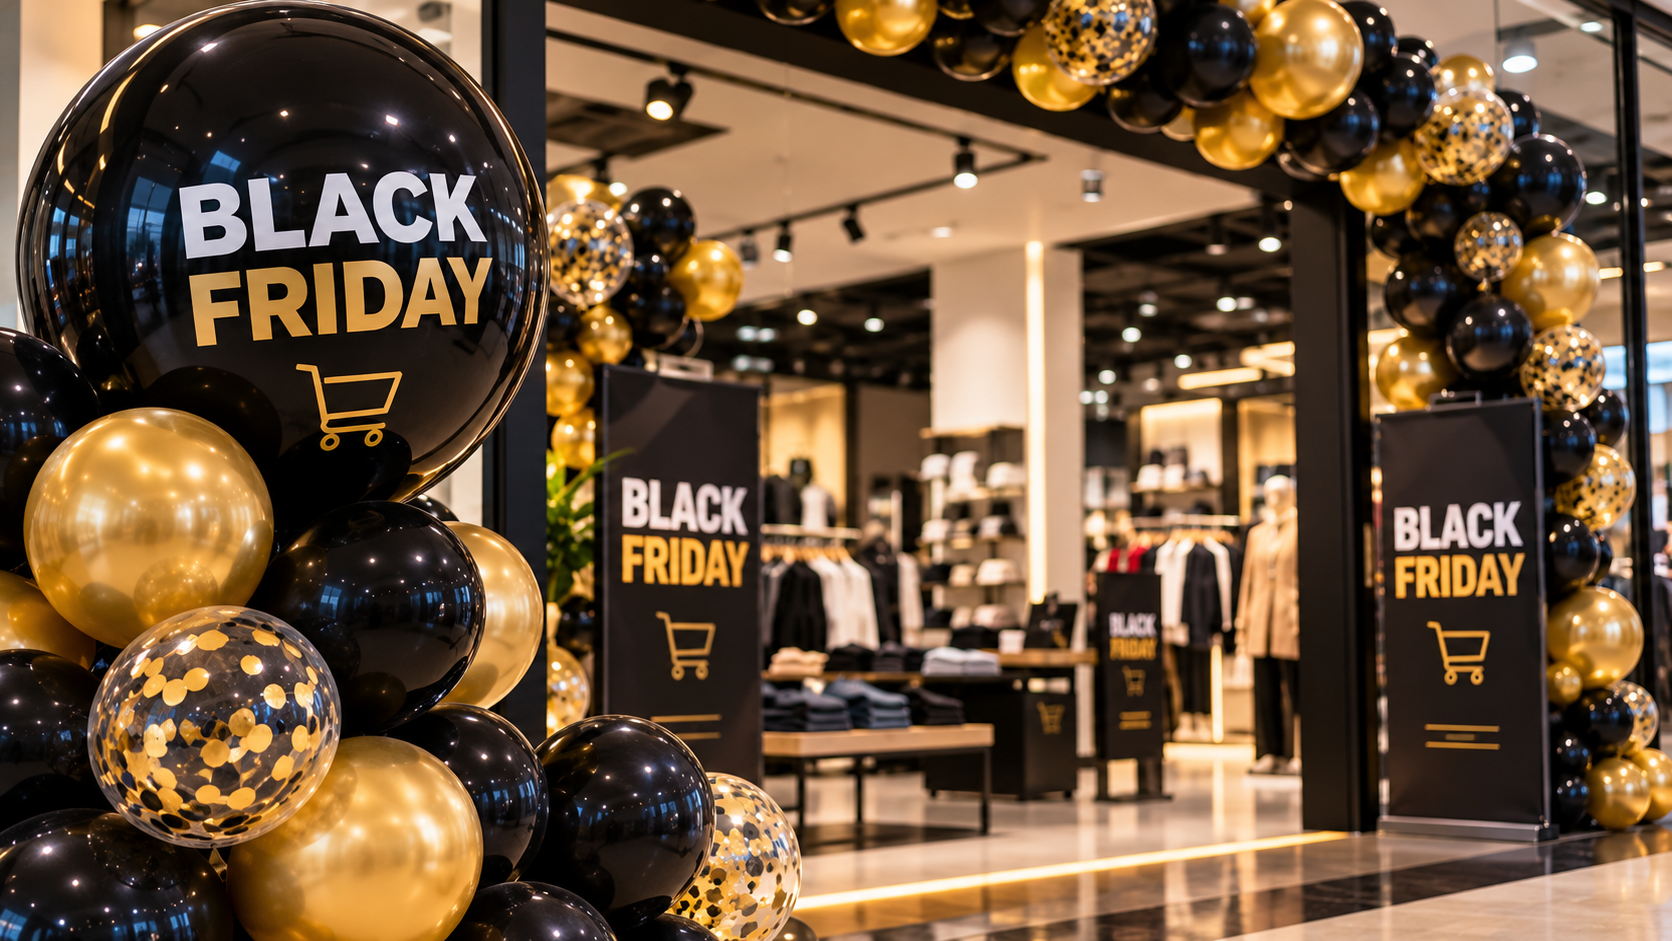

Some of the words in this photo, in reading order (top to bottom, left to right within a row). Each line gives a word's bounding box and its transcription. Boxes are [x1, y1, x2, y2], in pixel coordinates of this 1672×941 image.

[179, 171, 488, 259] BLACK
[188, 257, 493, 347] FRIDAY
[622, 477, 748, 535] BLACK
[1393, 501, 1524, 551] BLACK
[622, 534, 750, 587] FRIDAY
[1394, 552, 1525, 599] FRIDAY
[1109, 612, 1157, 637] BLACK
